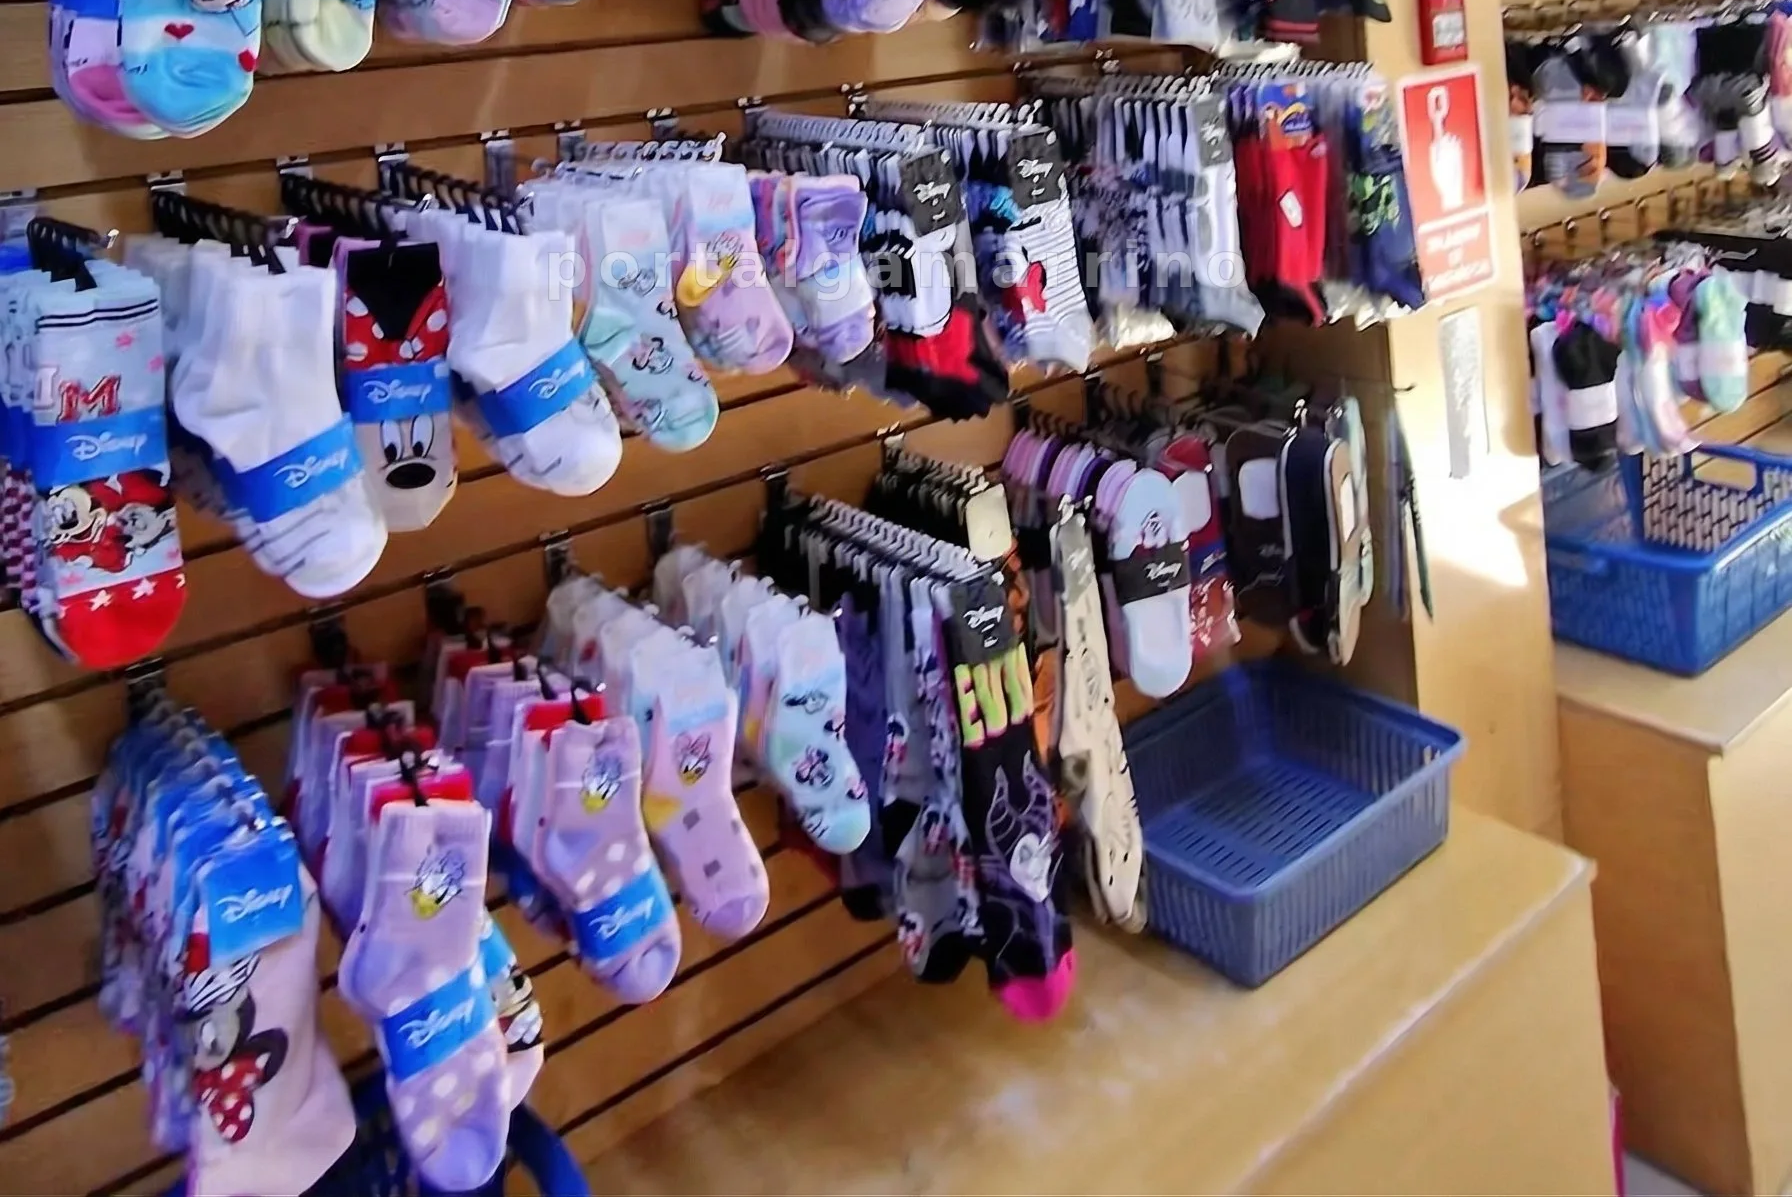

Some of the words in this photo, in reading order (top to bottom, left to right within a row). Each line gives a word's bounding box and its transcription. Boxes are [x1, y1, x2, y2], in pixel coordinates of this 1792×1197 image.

[362, 379, 432, 404] Disney
[528, 359, 586, 399] Disney
[65, 431, 148, 462] Disney
[273, 447, 349, 489] Disney
[215, 883, 293, 924] Disney
[588, 895, 655, 941] Disney
[397, 997, 476, 1050] Disney
